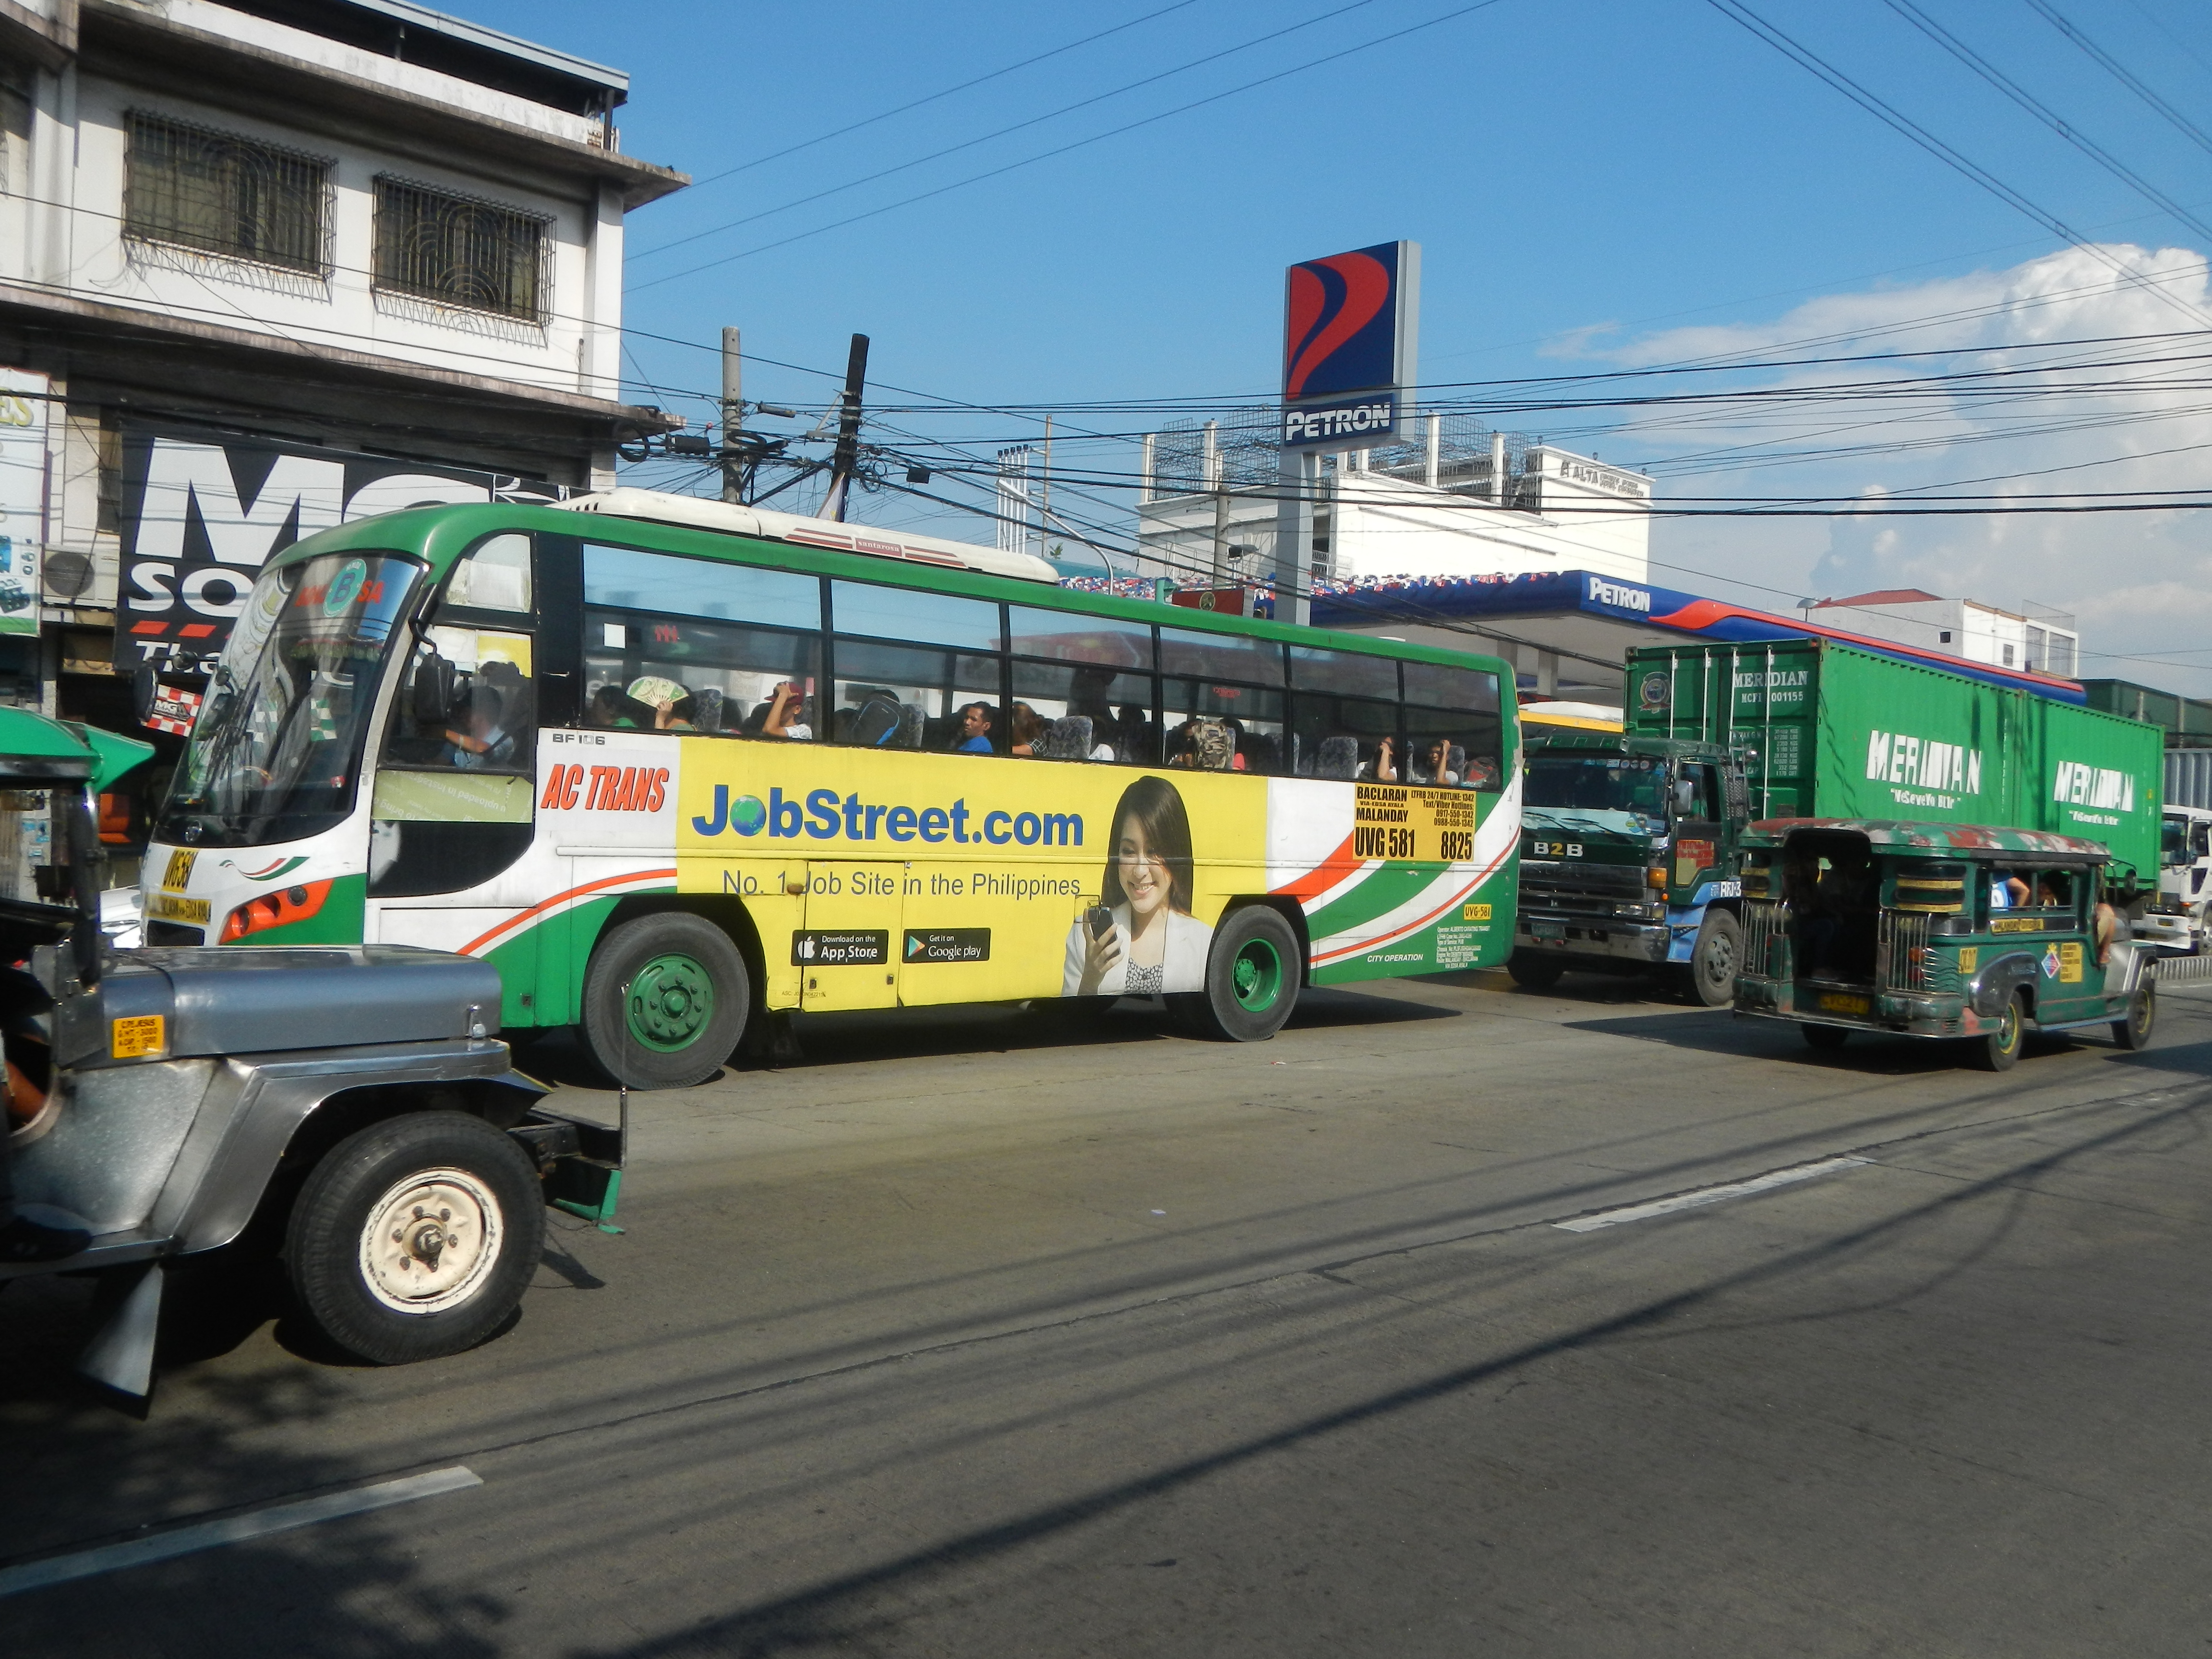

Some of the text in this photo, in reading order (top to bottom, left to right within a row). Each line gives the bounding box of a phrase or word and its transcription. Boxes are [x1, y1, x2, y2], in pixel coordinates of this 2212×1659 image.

[1286, 402, 1390, 441] PETRON
[858, 540, 900, 552] santarosa
[1588, 577, 1650, 612] PETRON
[1734, 671, 1809, 687] MERIDIAN
[1771, 691, 1803, 702] 001155
[540, 763, 670, 812] AC TRANS
[1357, 786, 1407, 802] BACLARAN
[1411, 790, 1474, 802] LTFRB 24/7 HOTLINE: 1342
[1423, 800, 1451, 809] Text/Viber
[692, 784, 1084, 847] JobStreet.com
[1356, 807, 1408, 822] MALANDAY
[1436, 809, 1474, 819] 0917-550-1342
[1434, 818, 1474, 828] 0988-550-1342
[1355, 827, 1415, 857] UVG 581
[1441, 831, 1472, 860] 8825
[1534, 842, 1584, 857] B2B
[722, 870, 1081, 901] No. 1 Job Site in the Philippines
[822, 935, 854, 943] Download
[820, 945, 878, 962] App Store
[928, 945, 981, 960] Google play
